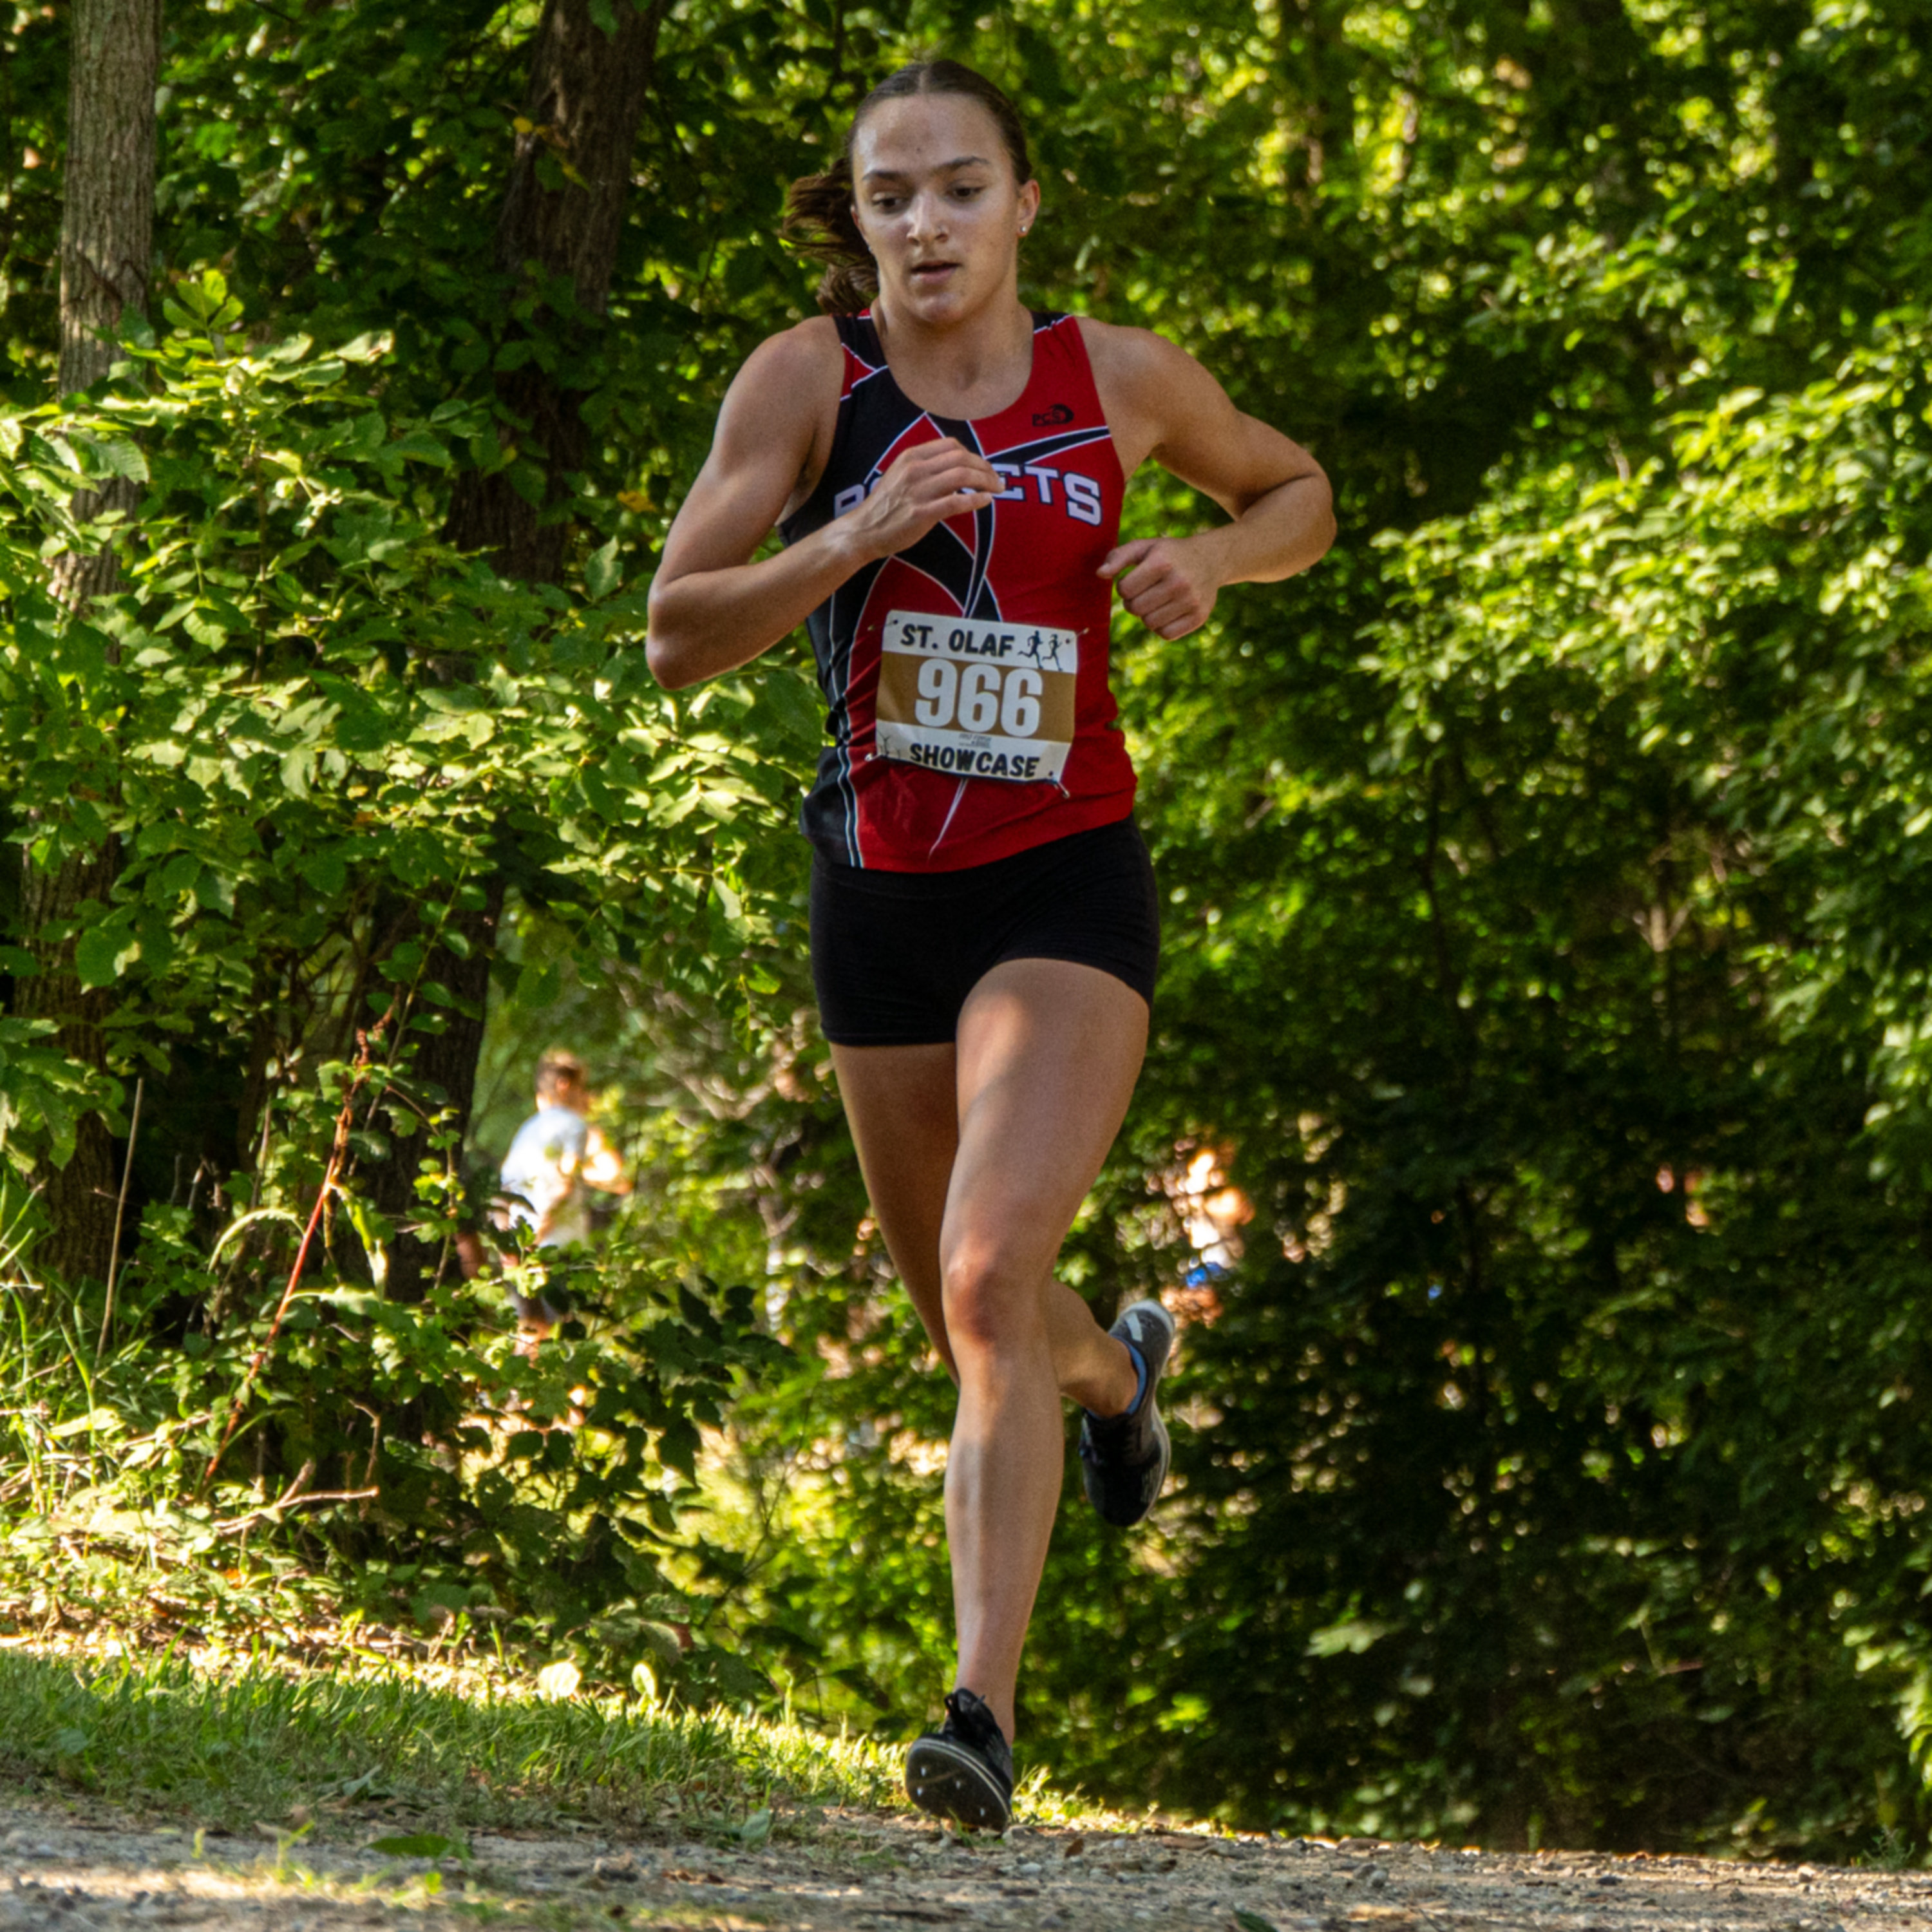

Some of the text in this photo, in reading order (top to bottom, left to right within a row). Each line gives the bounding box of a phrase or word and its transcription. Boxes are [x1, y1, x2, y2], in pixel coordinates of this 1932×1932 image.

[900, 624, 1014, 658] ST. OLAF
[914, 658, 1043, 737] 966
[909, 743, 1039, 778] SHOWCASE
